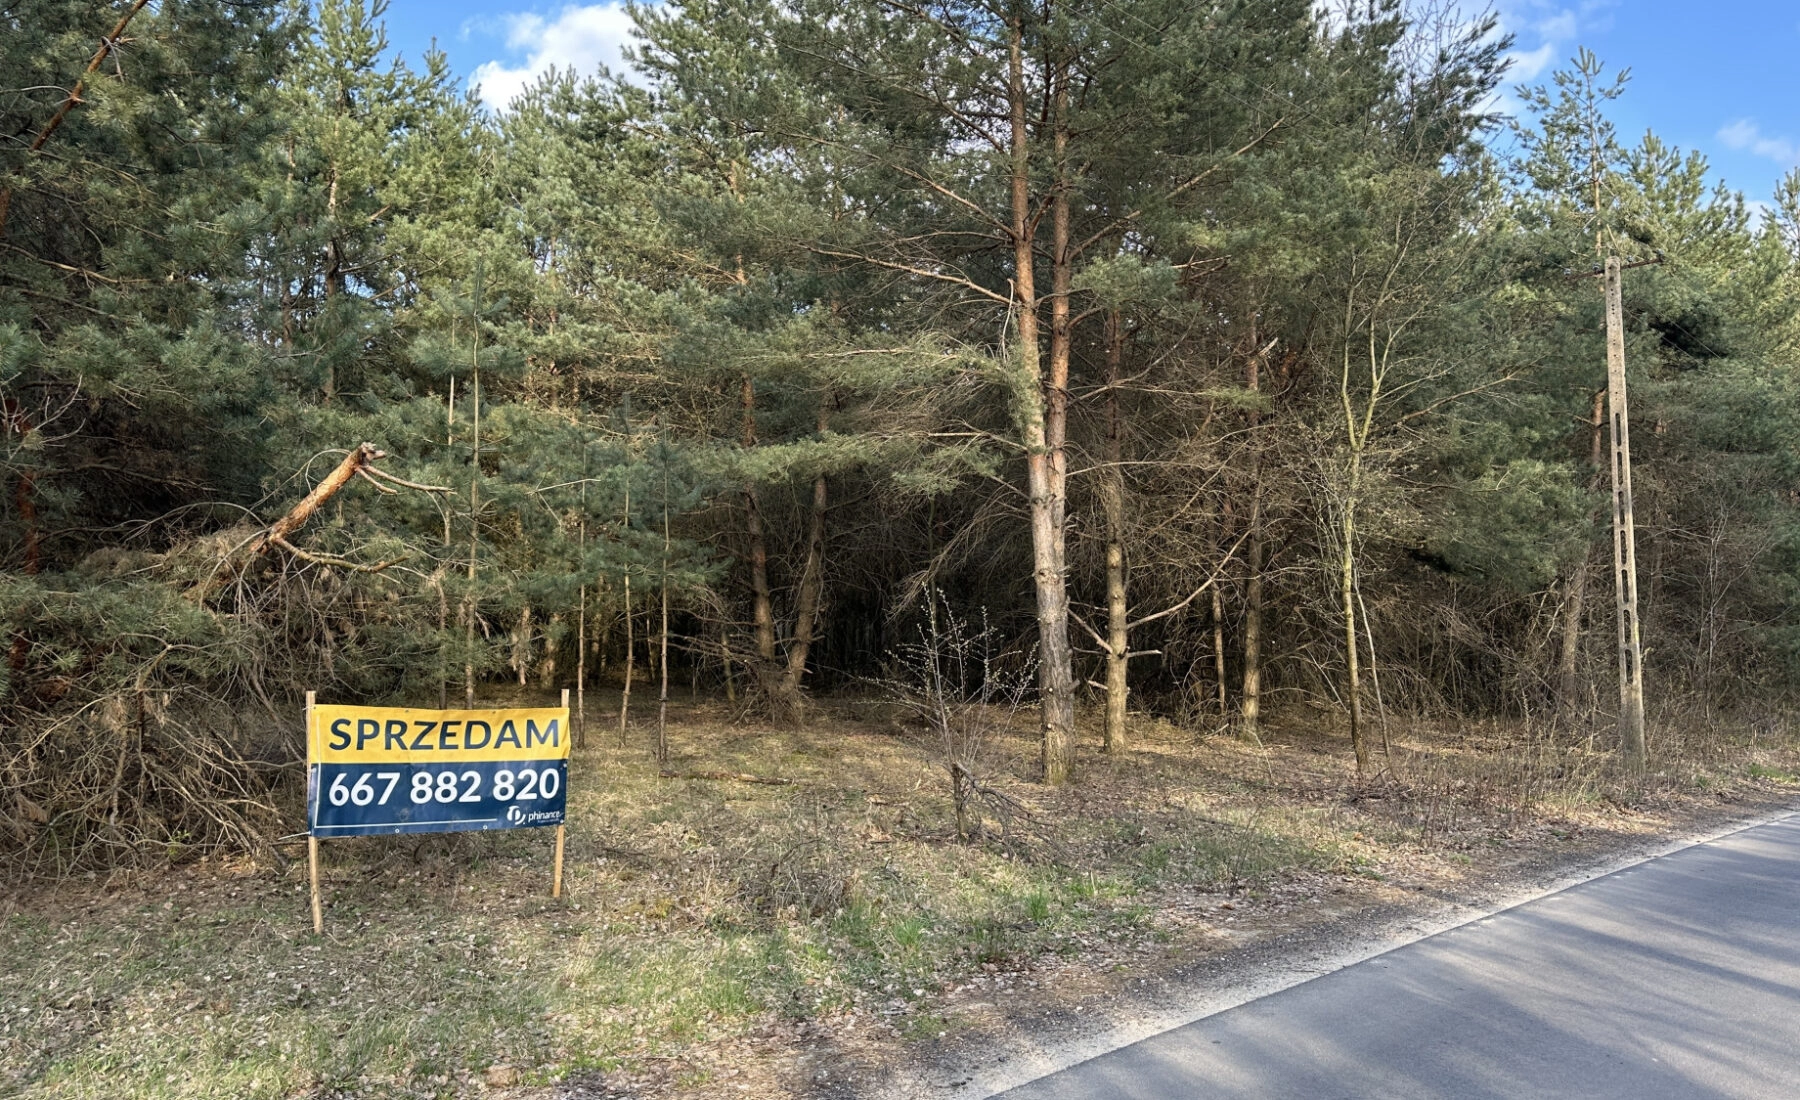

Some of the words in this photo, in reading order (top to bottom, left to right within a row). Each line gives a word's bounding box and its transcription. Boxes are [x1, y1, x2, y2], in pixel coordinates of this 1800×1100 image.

[329, 718, 558, 751] SPRZEDAM
[329, 772, 400, 806] 667
[410, 771, 481, 805] 882
[492, 768, 559, 801] 820
[528, 810, 560, 823] phinance
